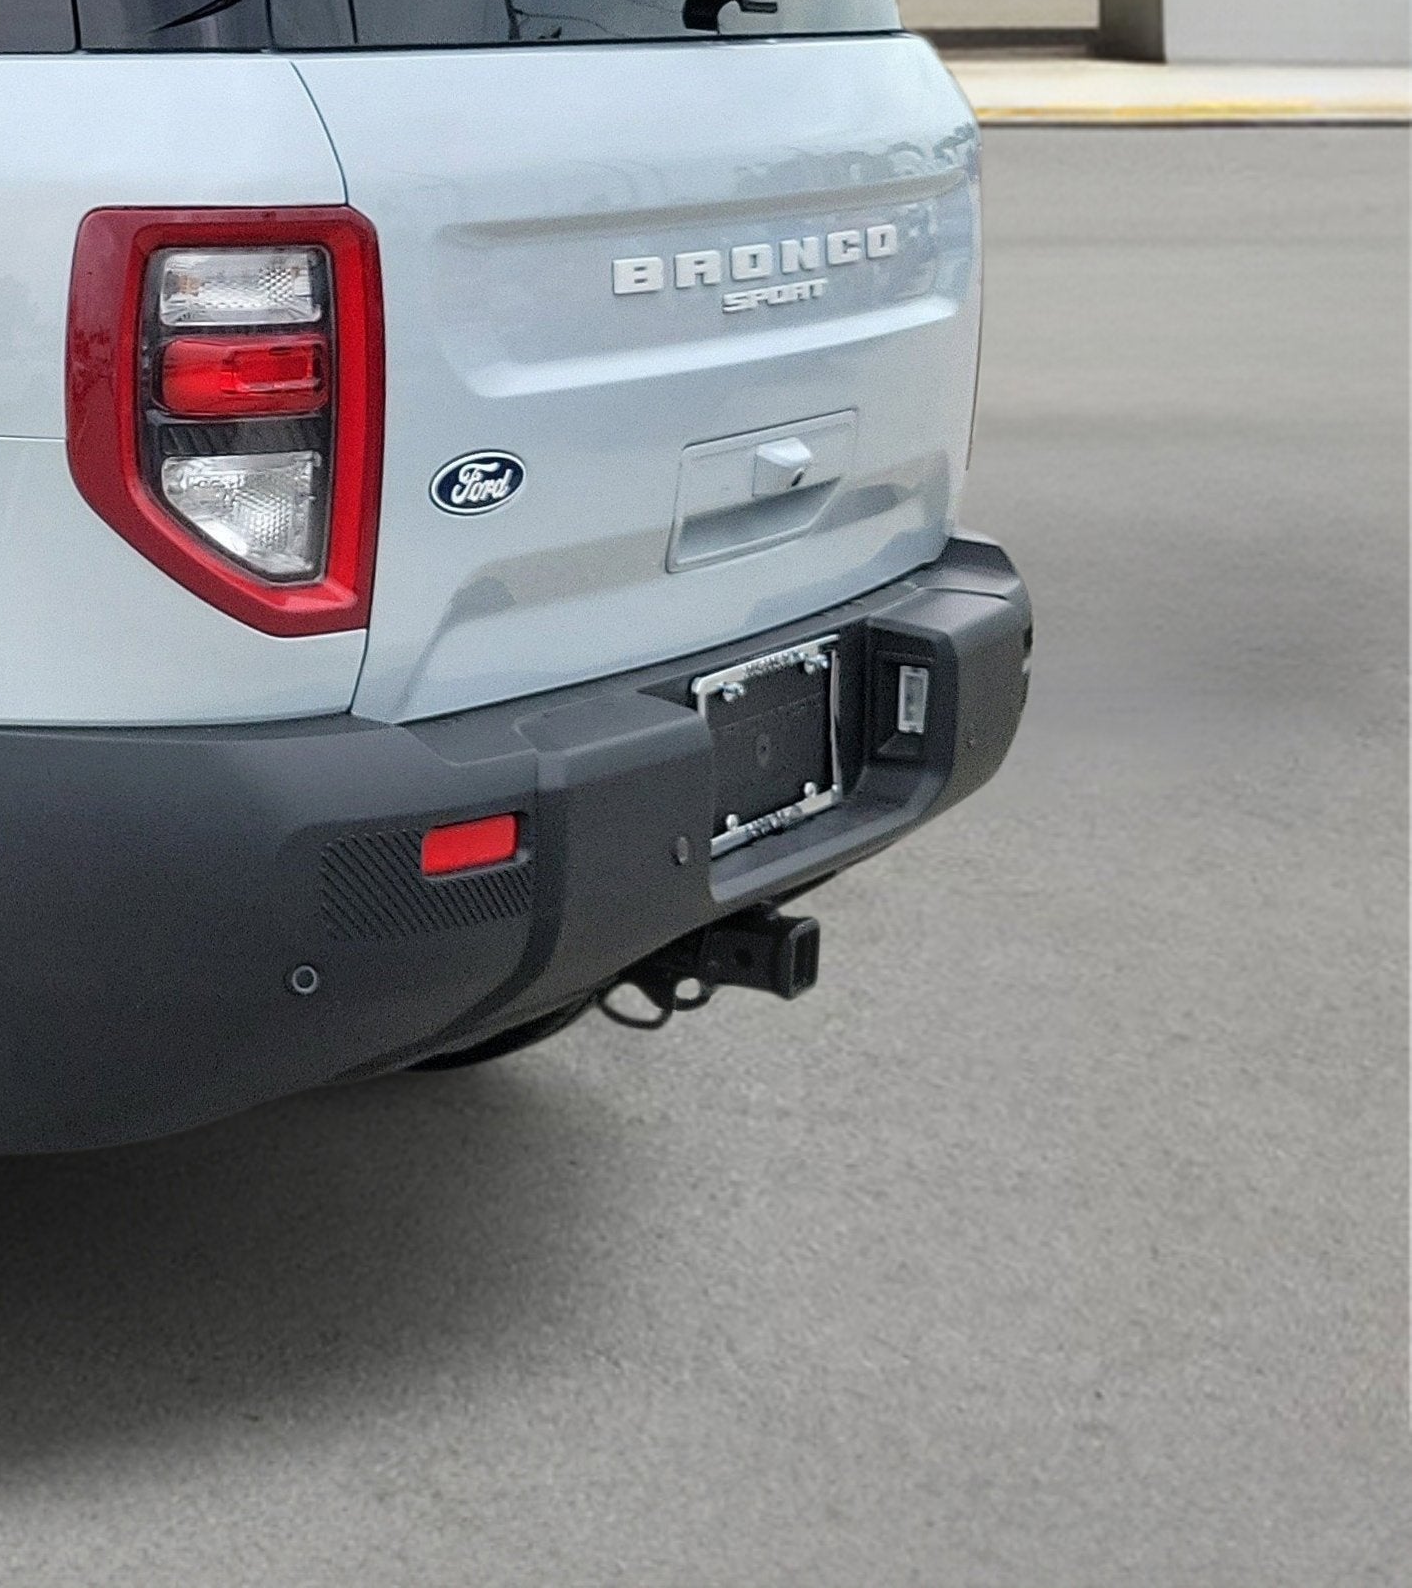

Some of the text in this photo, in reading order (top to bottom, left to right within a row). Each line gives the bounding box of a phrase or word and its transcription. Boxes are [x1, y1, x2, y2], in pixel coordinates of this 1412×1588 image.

[612, 224, 898, 295] BRONCO
[722, 278, 829, 314] SPORT
[450, 462, 513, 504] Ford
